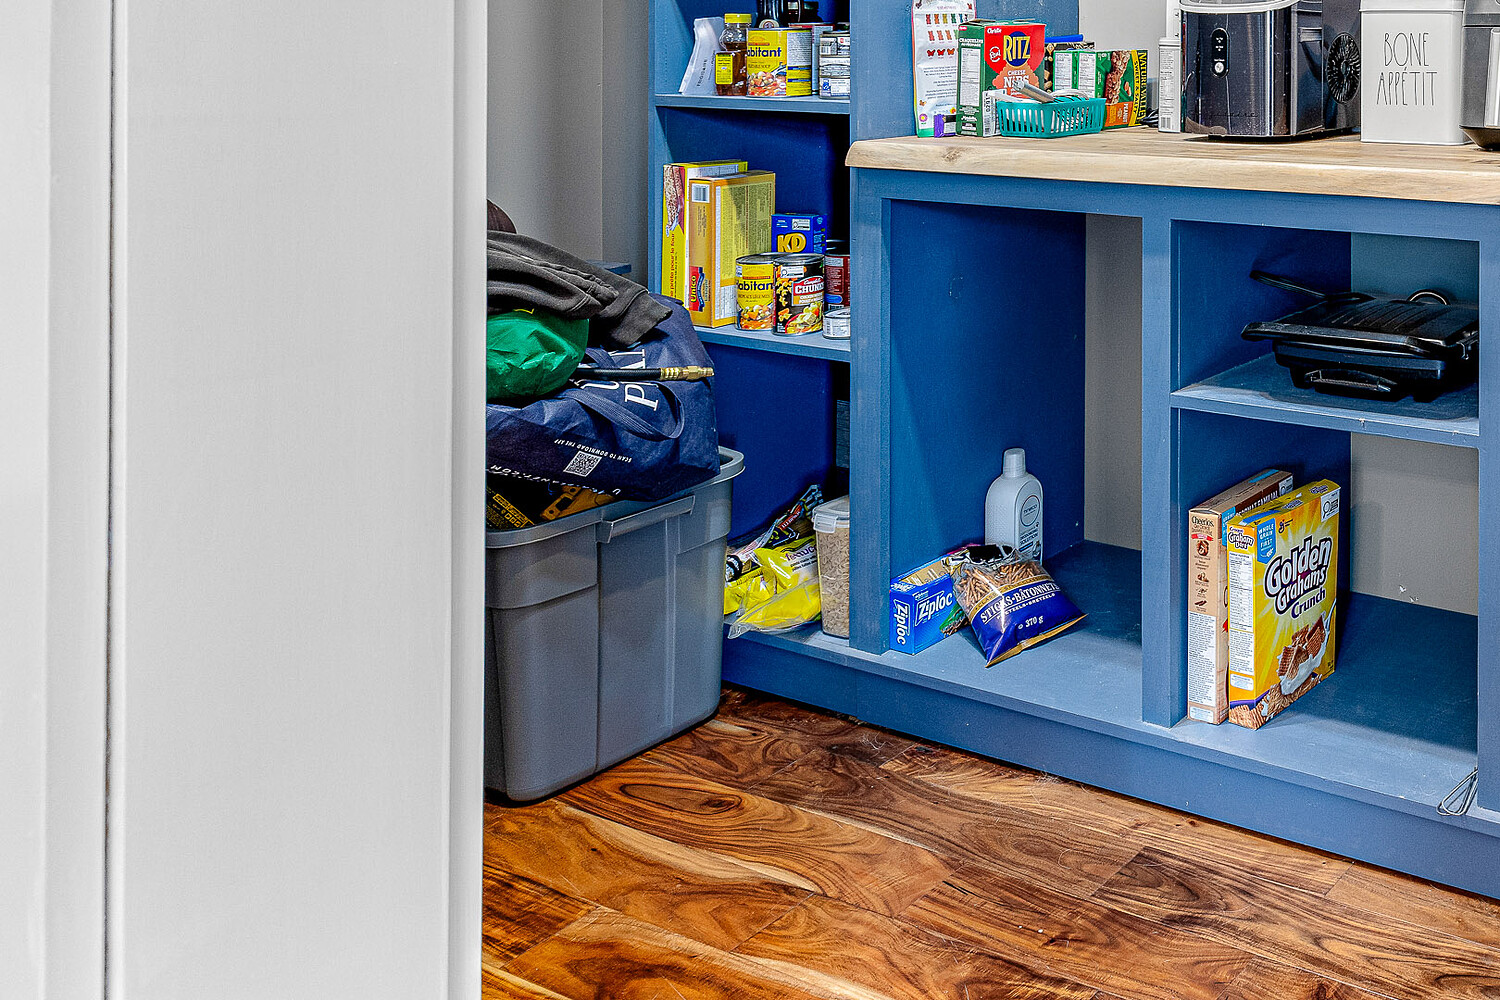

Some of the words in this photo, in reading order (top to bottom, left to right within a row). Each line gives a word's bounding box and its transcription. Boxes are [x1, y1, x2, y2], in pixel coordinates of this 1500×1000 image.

[1003, 35, 1031, 61] RITZ
[1384, 32, 1429, 67] BONE
[1138, 52, 1147, 87] NATURE
[1377, 68, 1437, 106] APPÉTIT
[1258, 523, 1274, 534] WHOLE
[1266, 538, 1331, 594] Golden
[918, 592, 953, 620] Ziploc
[1276, 567, 1326, 612] Grahams
[1292, 589, 1326, 618] Crunch
[894, 604, 908, 645] Ziploc
[1025, 617, 1038, 628] 370
